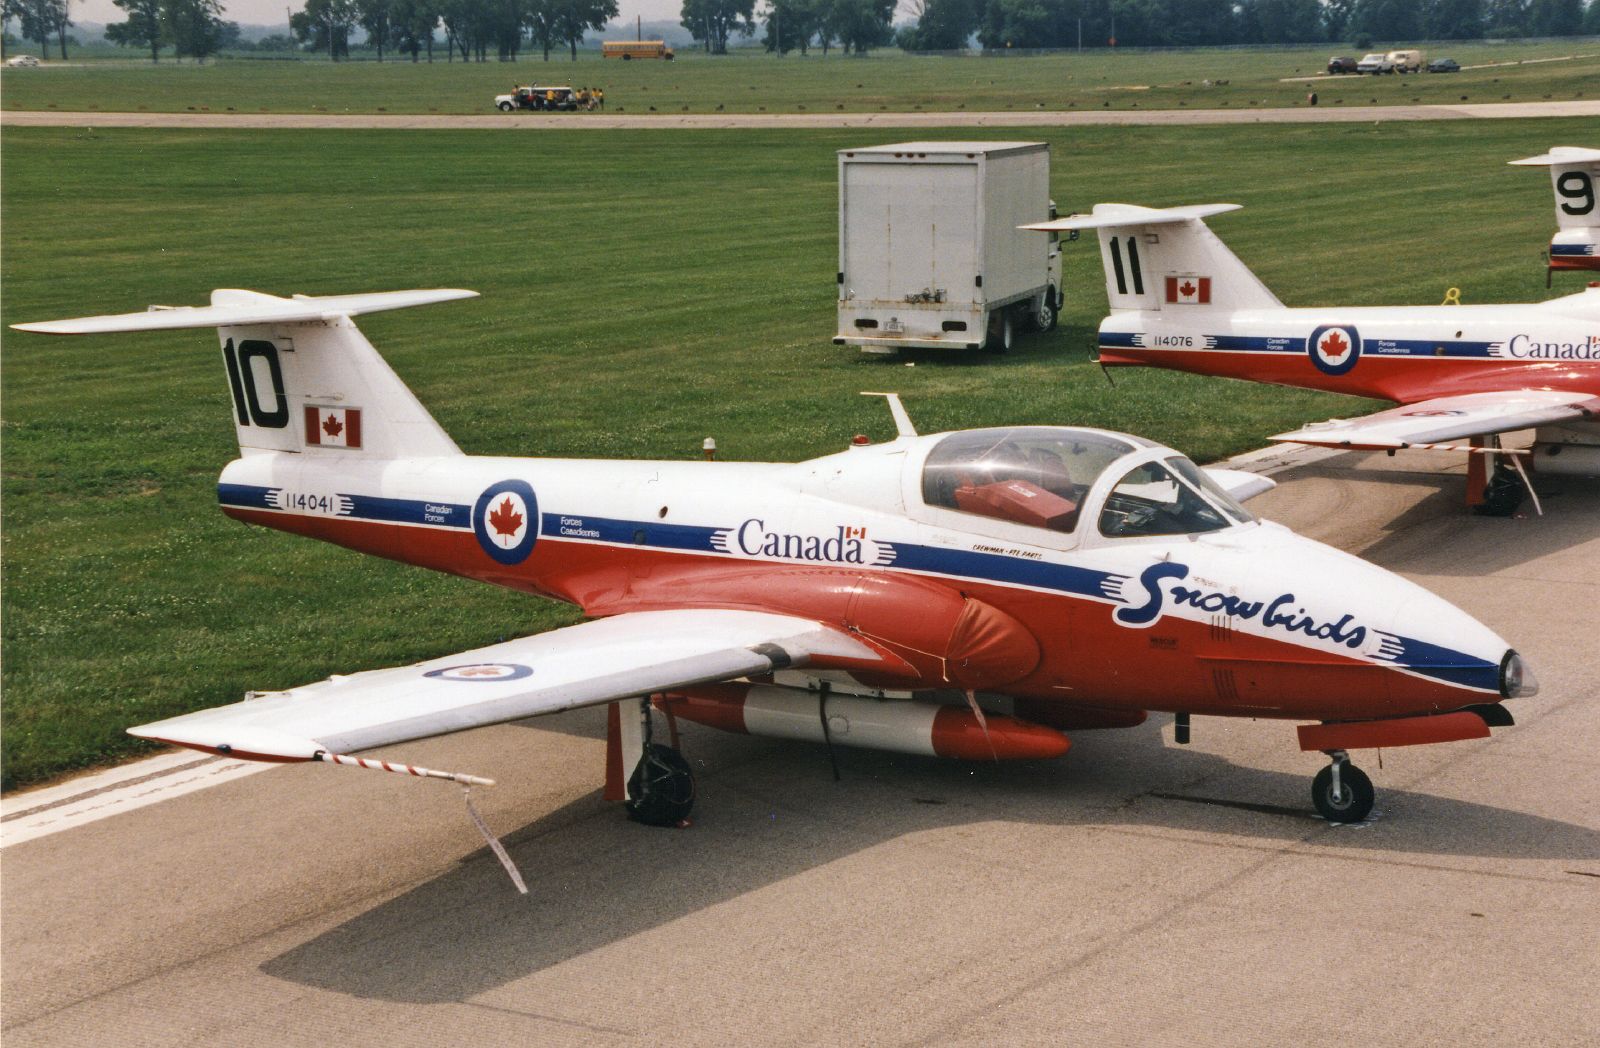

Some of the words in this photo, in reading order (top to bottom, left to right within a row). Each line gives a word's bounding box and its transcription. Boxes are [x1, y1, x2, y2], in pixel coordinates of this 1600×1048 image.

[1557, 171, 1595, 215] 9
[1109, 236, 1144, 295] 11
[1153, 335, 1193, 349] 114076
[1509, 334, 1600, 360] Canada
[223, 337, 289, 429] 10
[285, 493, 334, 513] 114041
[424, 503, 453, 514] Canadian
[424, 513, 445, 523] Forces
[560, 516, 583, 527] Forces
[737, 518, 864, 565] Canada
[1117, 561, 1367, 648] Snowbirds
